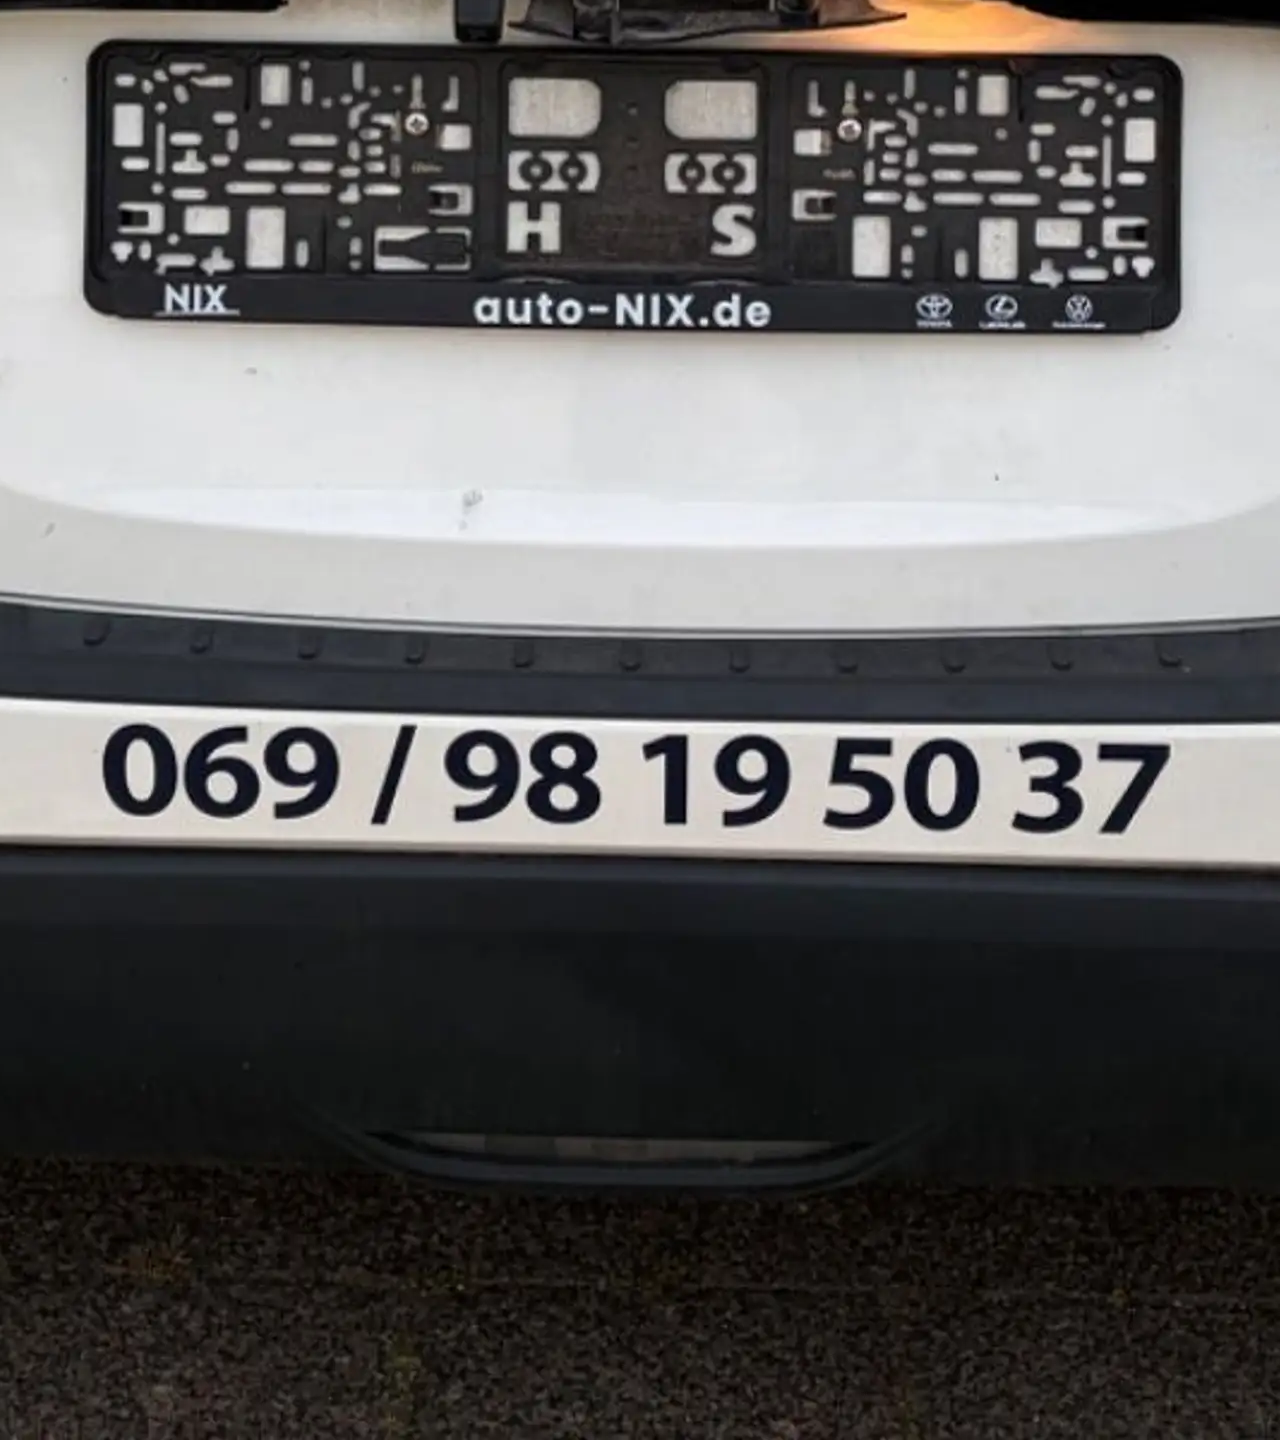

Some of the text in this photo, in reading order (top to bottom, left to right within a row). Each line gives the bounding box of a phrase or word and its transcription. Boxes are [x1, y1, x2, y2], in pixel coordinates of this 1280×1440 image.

[164, 283, 230, 313] NIX
[473, 291, 772, 328] auto-NIX.de
[102, 723, 1172, 835] 069 / 98 19 50 37
